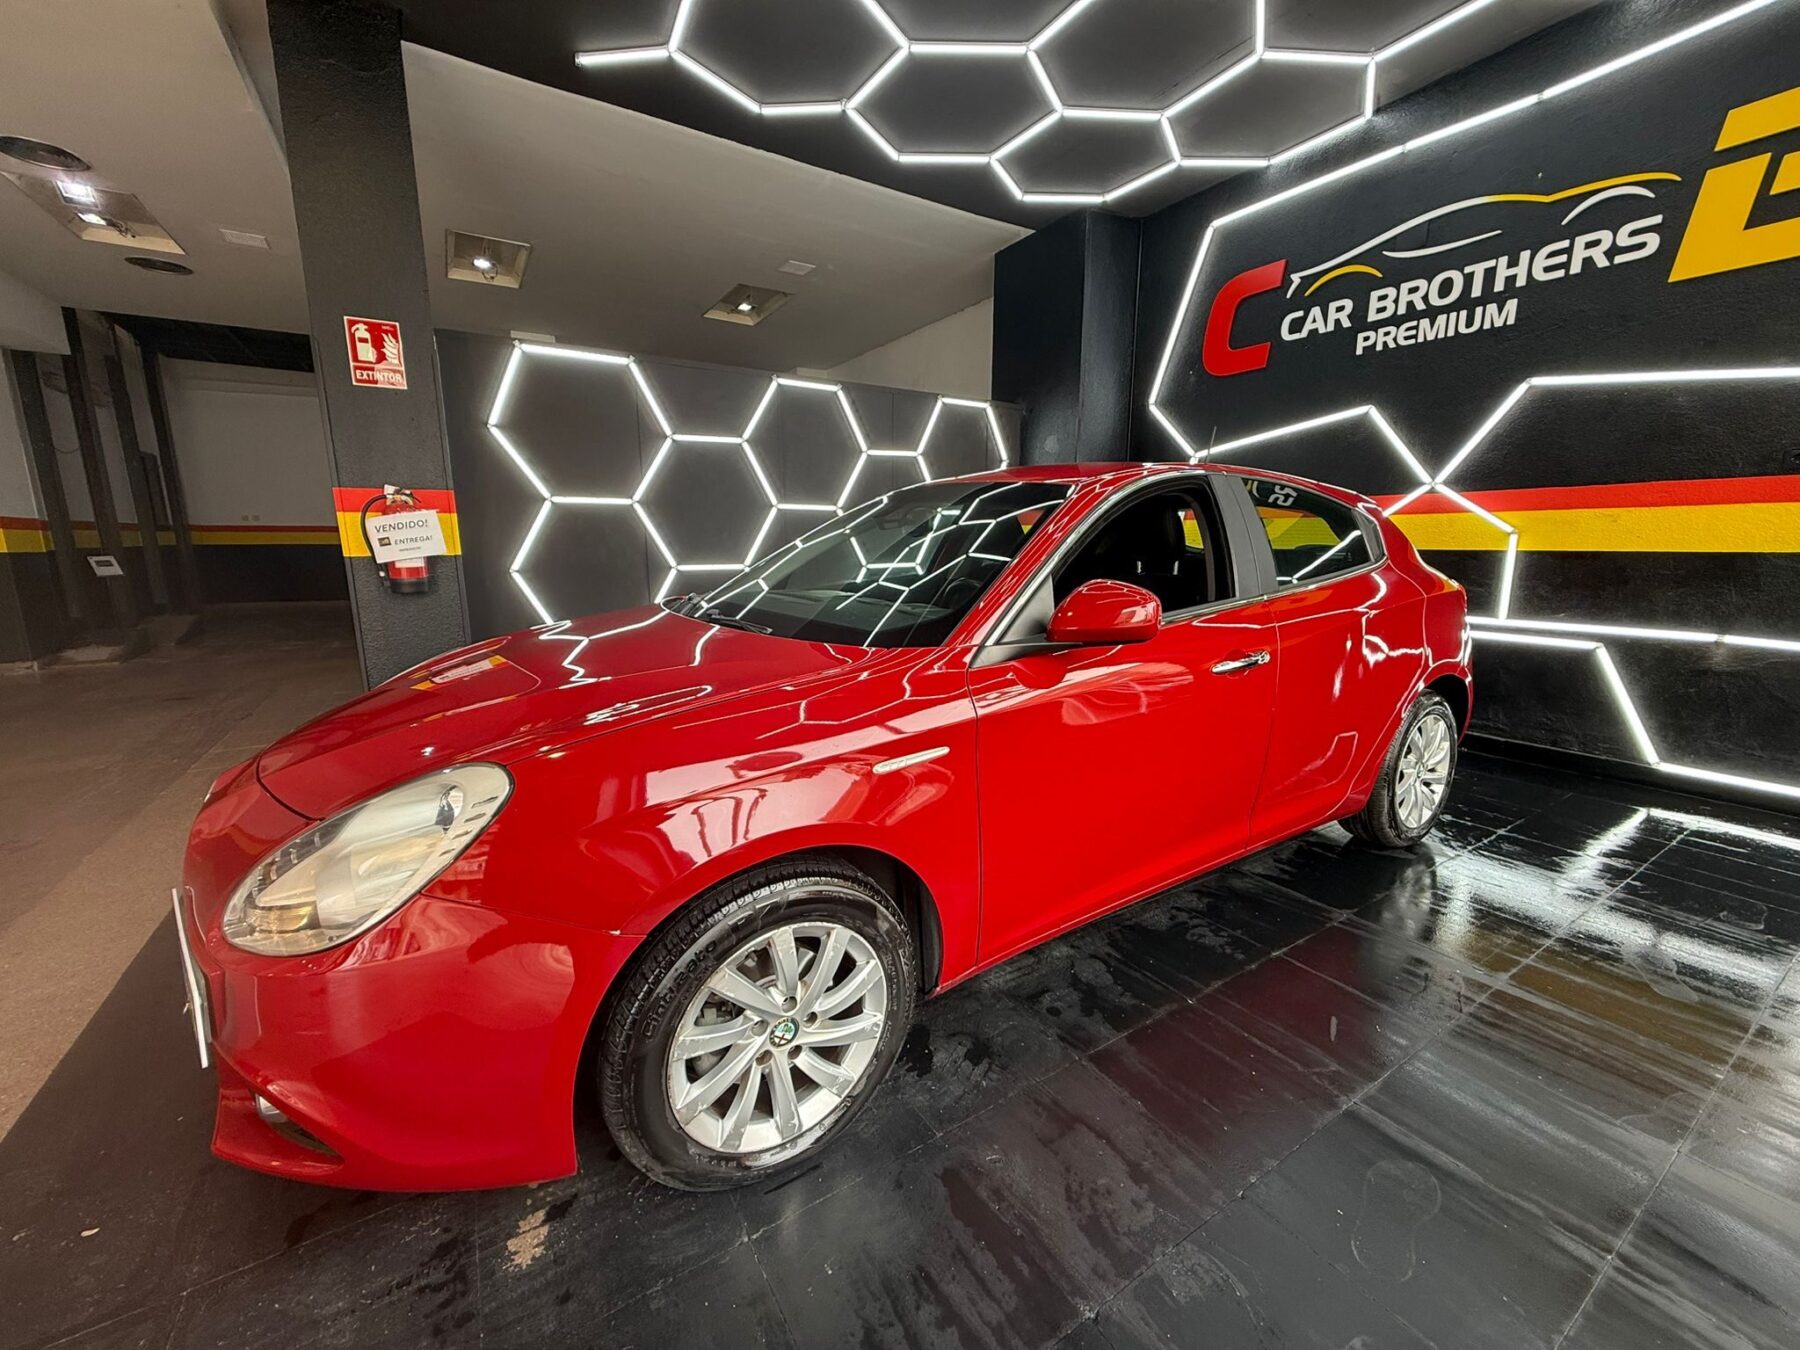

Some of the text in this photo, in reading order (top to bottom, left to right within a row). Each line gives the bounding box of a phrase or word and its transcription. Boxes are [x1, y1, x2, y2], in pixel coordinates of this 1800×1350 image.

[1281, 213, 1664, 342] CAR BROTHERS
[1202, 258, 1288, 377] C
[1355, 297, 1519, 356] PREMIUM
[355, 369, 402, 383] EXTINTOR
[374, 518, 429, 534] VENDIDO!
[394, 535, 433, 546] ENTREGA!
